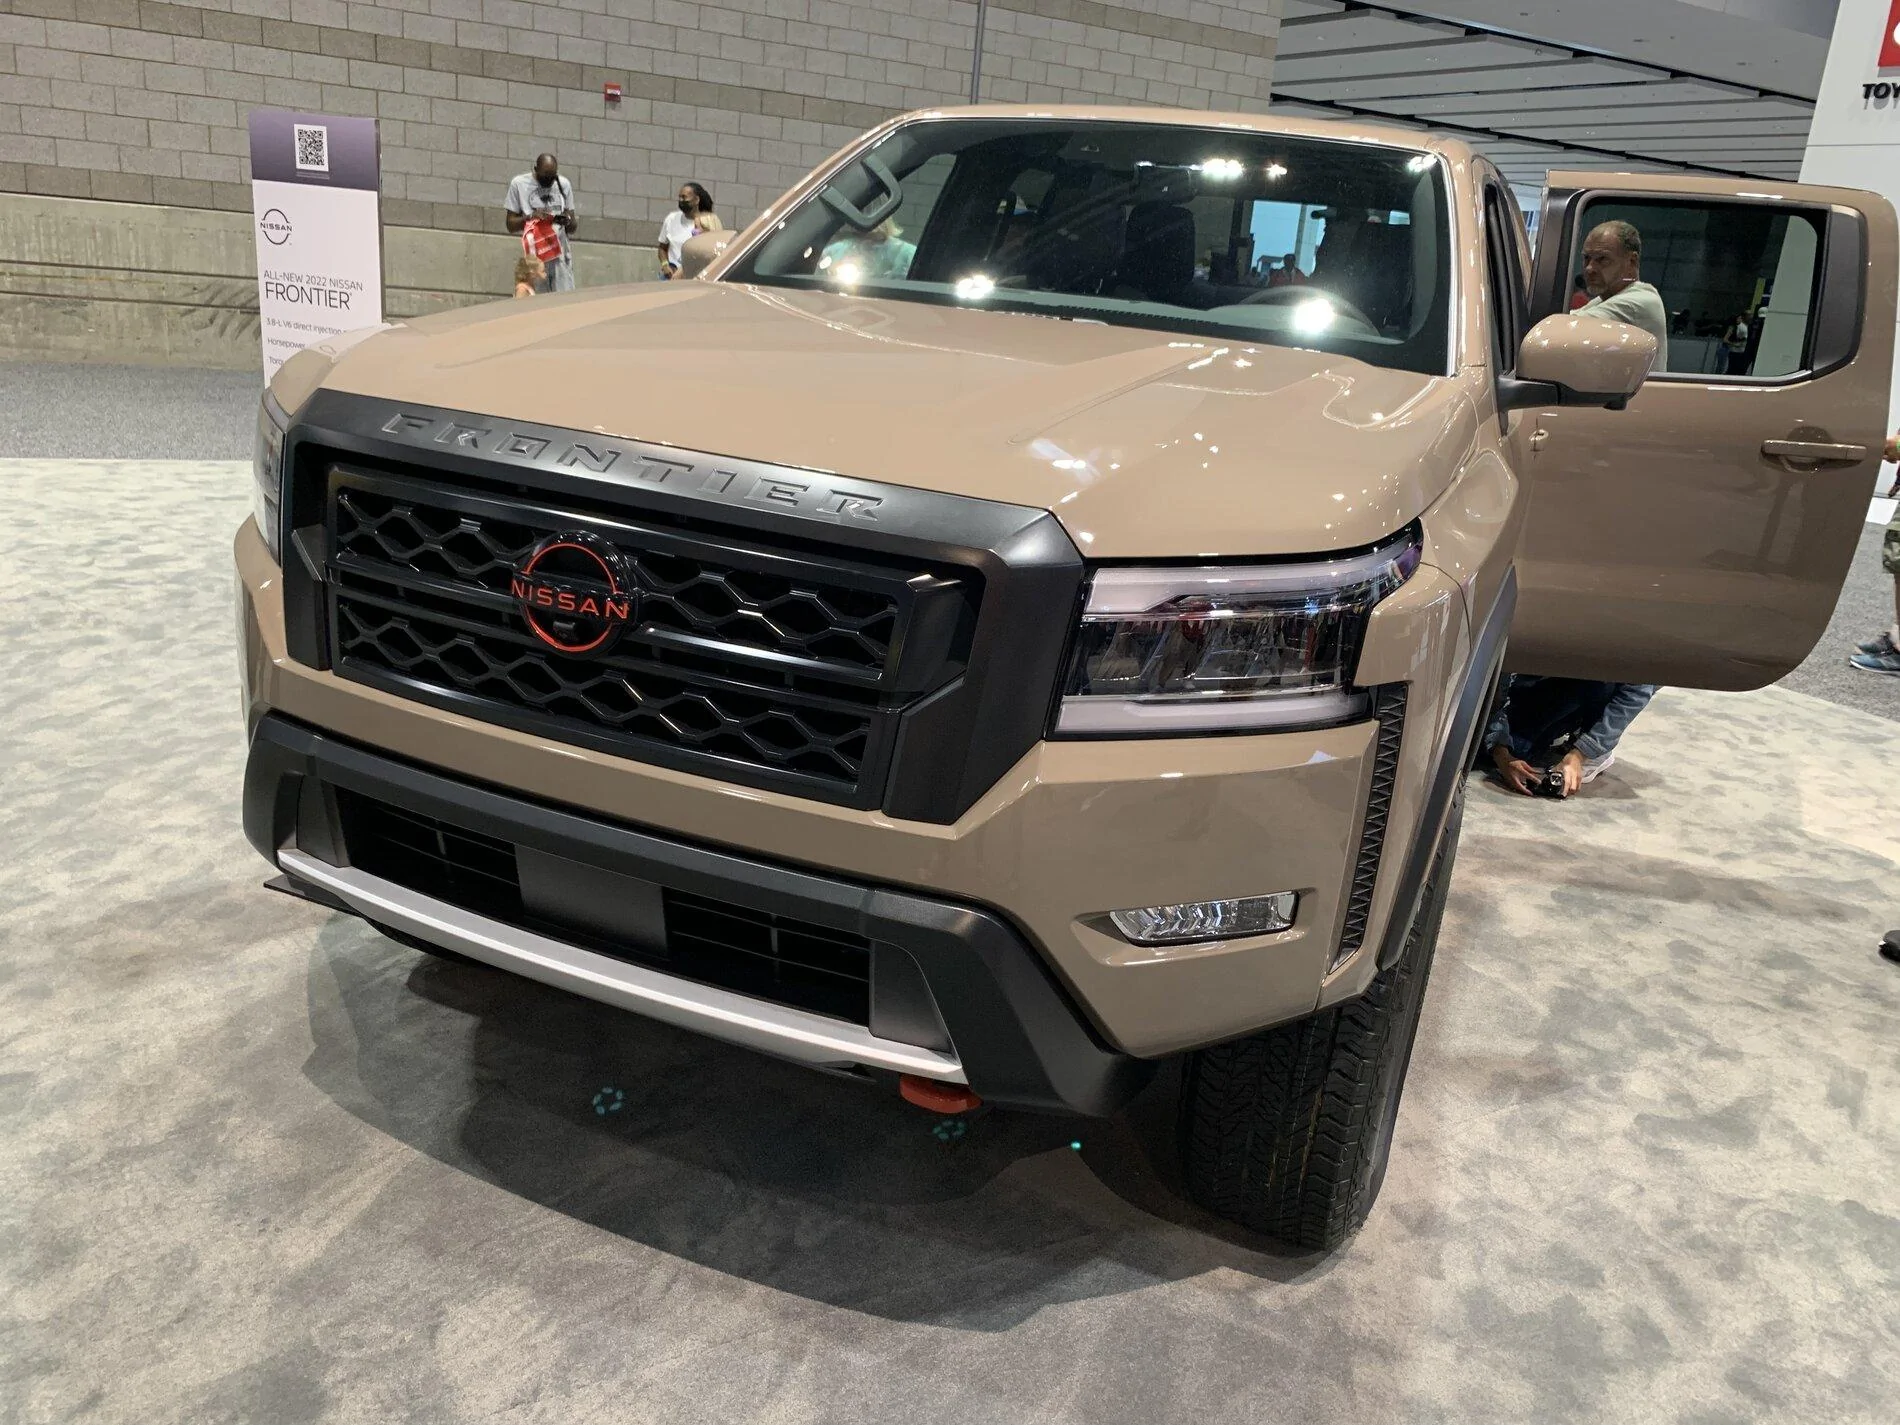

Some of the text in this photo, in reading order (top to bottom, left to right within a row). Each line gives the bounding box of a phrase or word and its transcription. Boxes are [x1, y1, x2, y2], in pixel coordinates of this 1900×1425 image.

[260, 221, 292, 232] NISSAN
[263, 269, 363, 291] ALL-NEW 2022 NISSAN
[265, 281, 351, 310] FRONTIER
[283, 319, 292, 329] V6
[293, 322, 312, 331] direct
[313, 325, 342, 336] injection
[267, 337, 305, 349] Horsepower
[381, 413, 885, 521] FRONTIER
[511, 578, 630, 620] NISSAN
